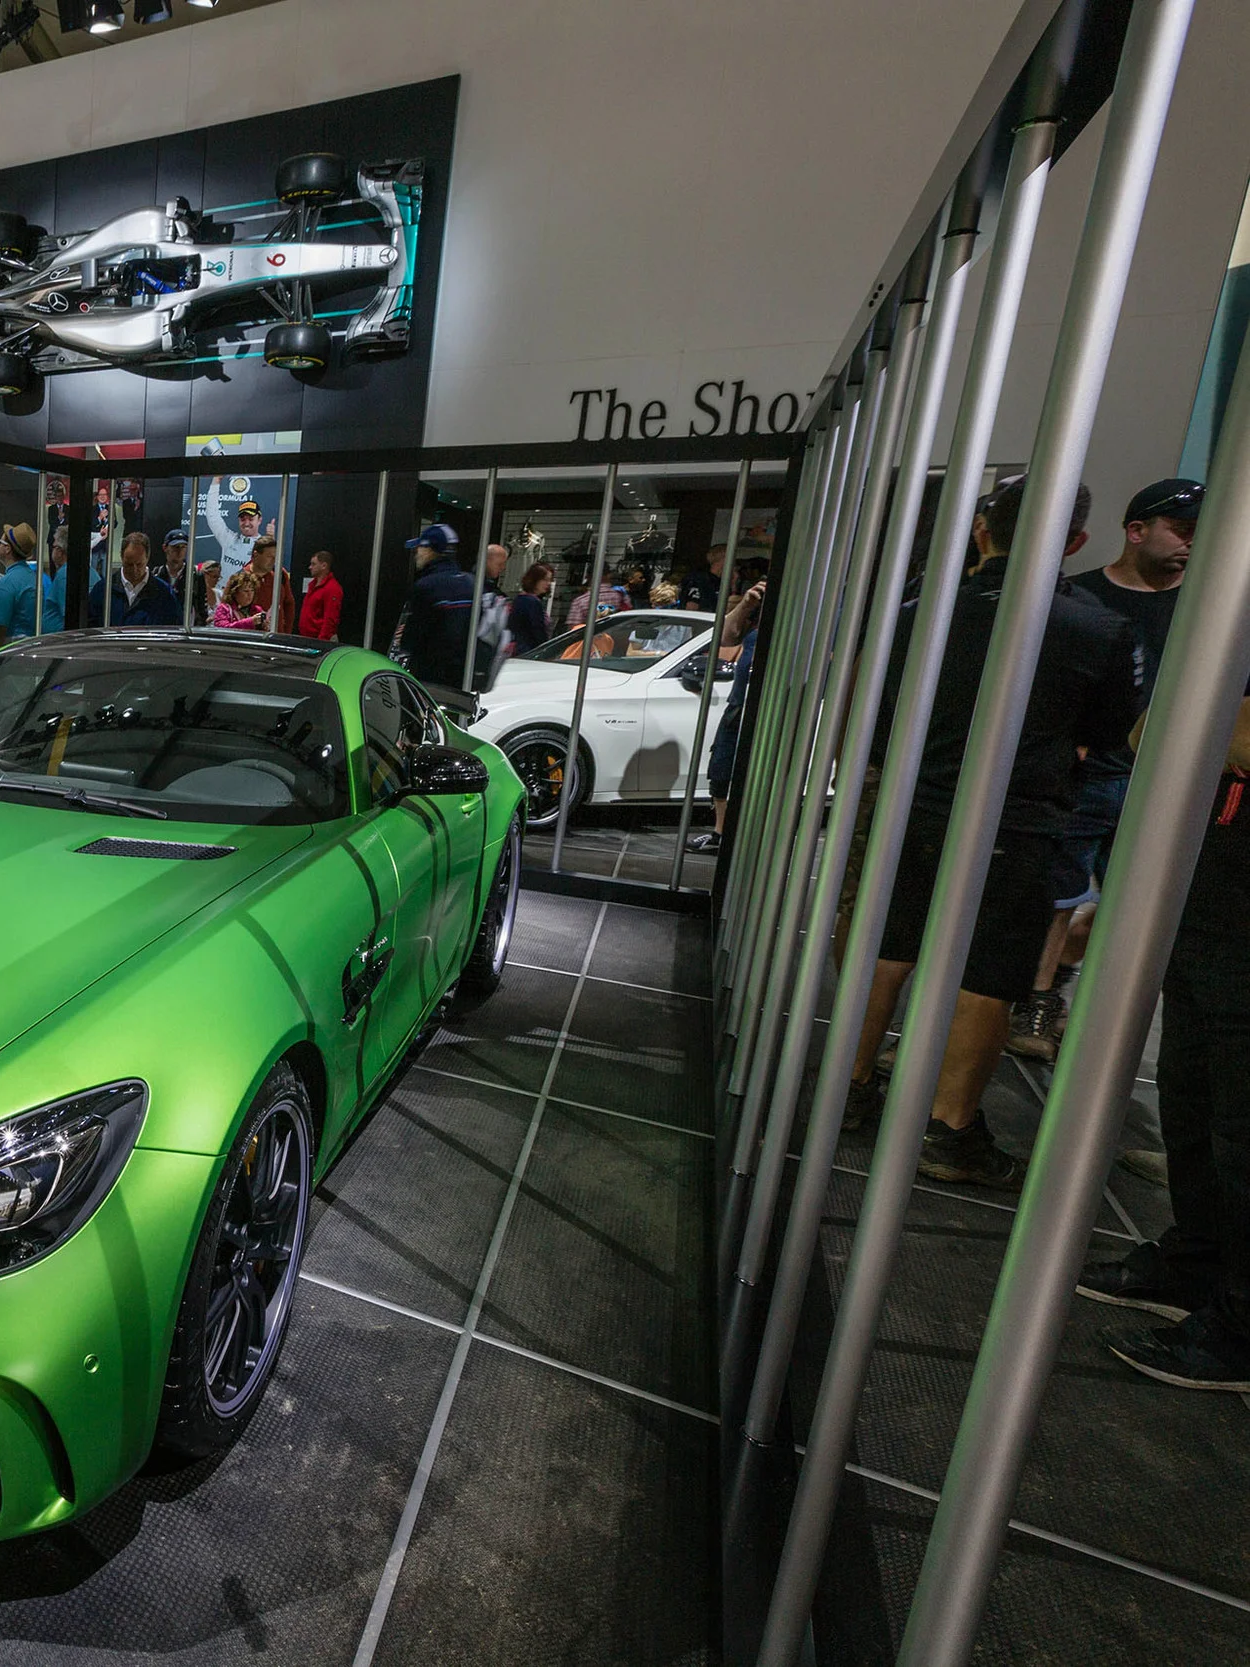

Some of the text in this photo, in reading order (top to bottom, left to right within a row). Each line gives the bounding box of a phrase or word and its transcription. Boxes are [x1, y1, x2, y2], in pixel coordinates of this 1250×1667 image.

[266, 253, 286, 267] 6
[569, 380, 816, 440] The Sho
